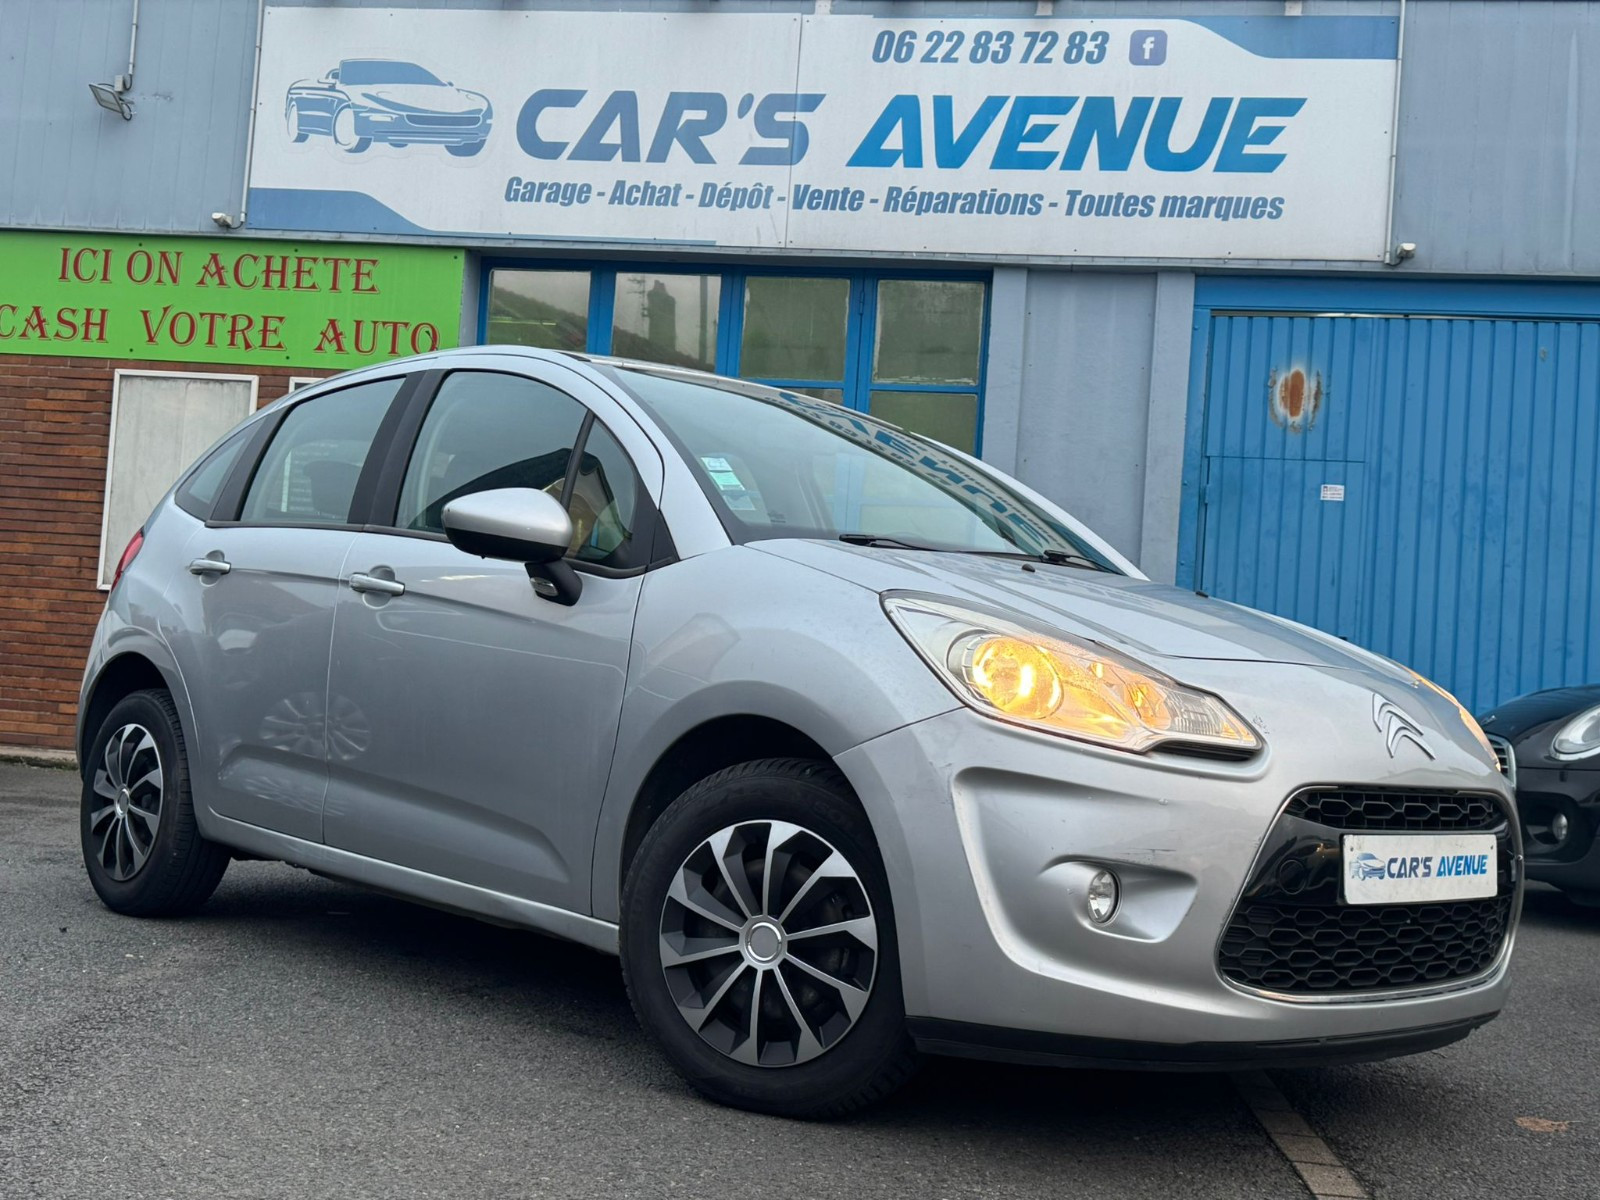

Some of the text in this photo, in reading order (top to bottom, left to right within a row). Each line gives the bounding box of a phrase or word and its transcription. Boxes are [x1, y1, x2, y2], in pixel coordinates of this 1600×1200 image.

[872, 30, 1109, 64] 06 22 83 72 83
[516, 88, 1308, 173] CAR'S AVENUE
[505, 176, 592, 207] Garage
[608, 179, 682, 207] Achat
[698, 181, 774, 211] Dépôt
[792, 184, 865, 212] Vente
[883, 185, 1044, 216] Réparations
[1065, 189, 1154, 217] Toutes
[1159, 195, 1285, 222] marques
[58, 247, 380, 294] ICI ON ACHETE
[0, 304, 440, 356] CASH VOTRE AUTO
[1387, 854, 1489, 879] CAR'S AVENUE
